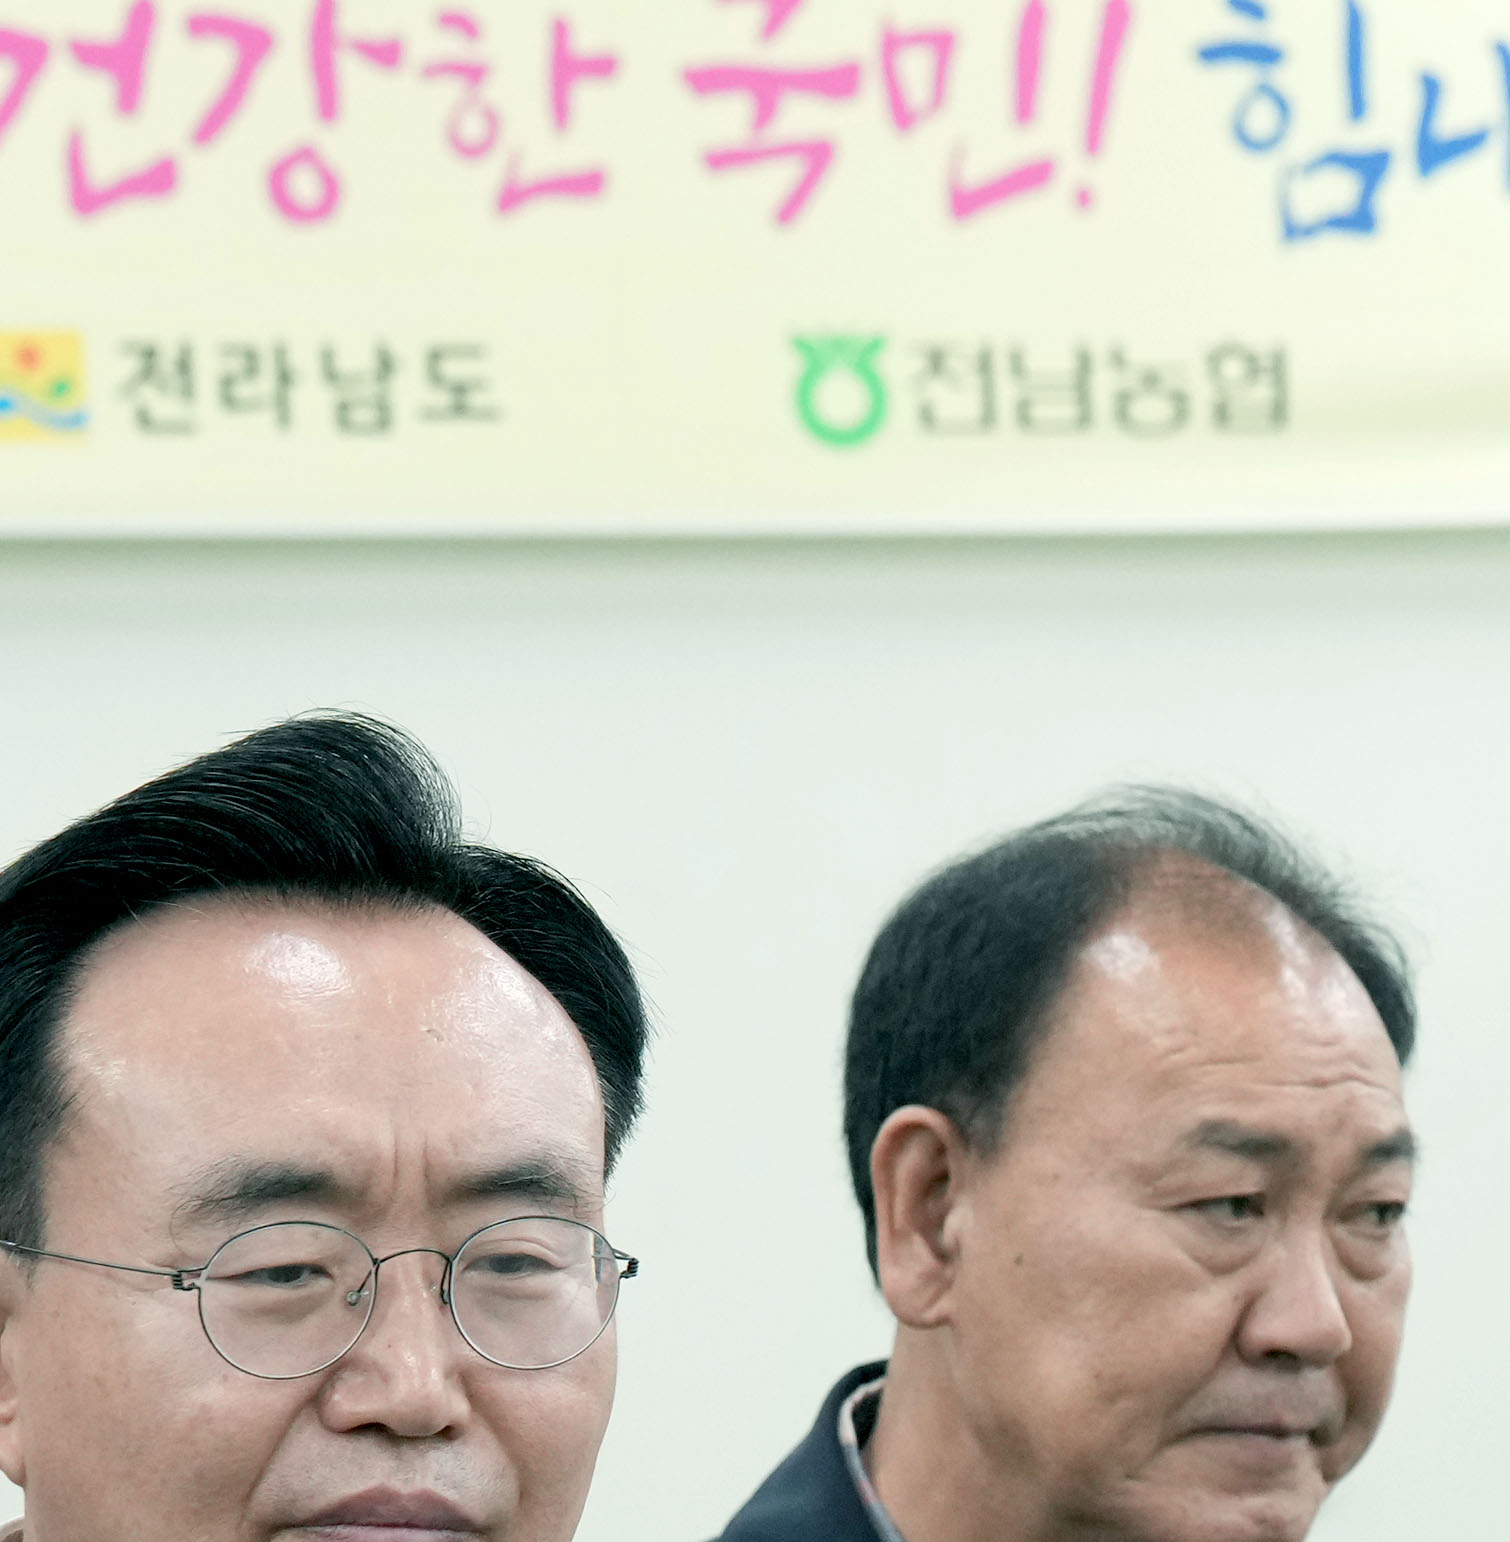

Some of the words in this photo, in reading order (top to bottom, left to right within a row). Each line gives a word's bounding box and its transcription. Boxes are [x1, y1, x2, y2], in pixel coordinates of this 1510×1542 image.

[682, 0, 1132, 224] 국민!
[120, 338, 500, 436] 전라남도
[912, 341, 1292, 437] 전남농협
